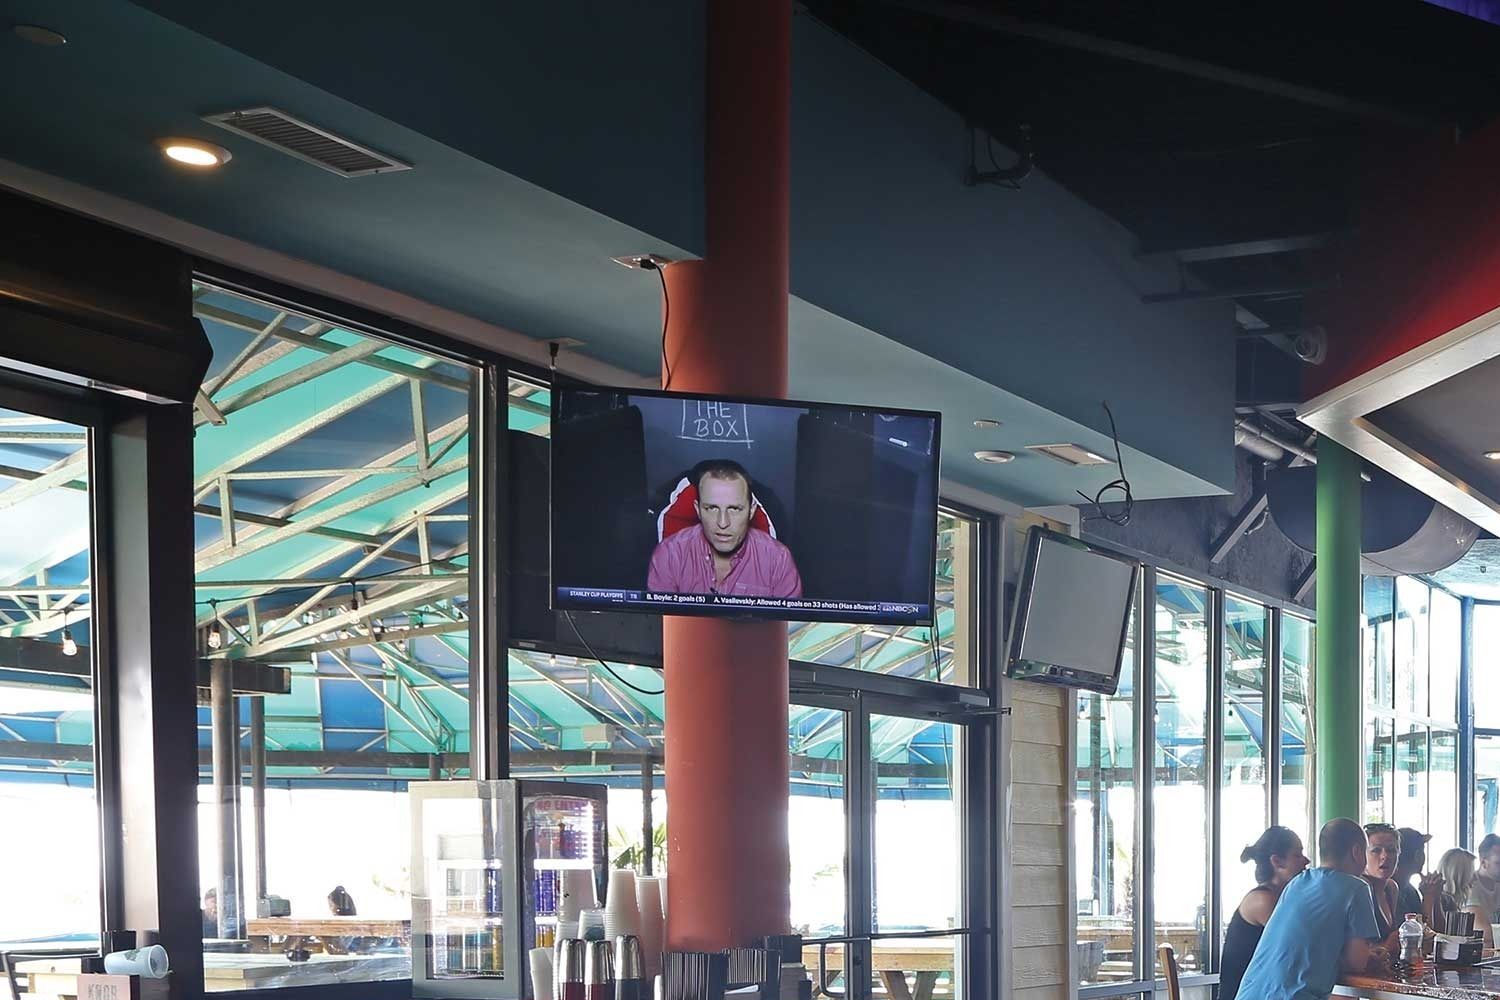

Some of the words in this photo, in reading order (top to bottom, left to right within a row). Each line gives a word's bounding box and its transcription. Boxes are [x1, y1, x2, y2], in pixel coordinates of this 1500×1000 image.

[696, 400, 731, 418] THE
[694, 419, 738, 437] BOX
[570, 590, 590, 598] STANLEY
[654, 594, 672, 602] Boyle:
[678, 595, 695, 603] goals
[756, 598, 781, 606] Allowed
[787, 600, 802, 608] goals
[839, 602, 852, 610] (Has
